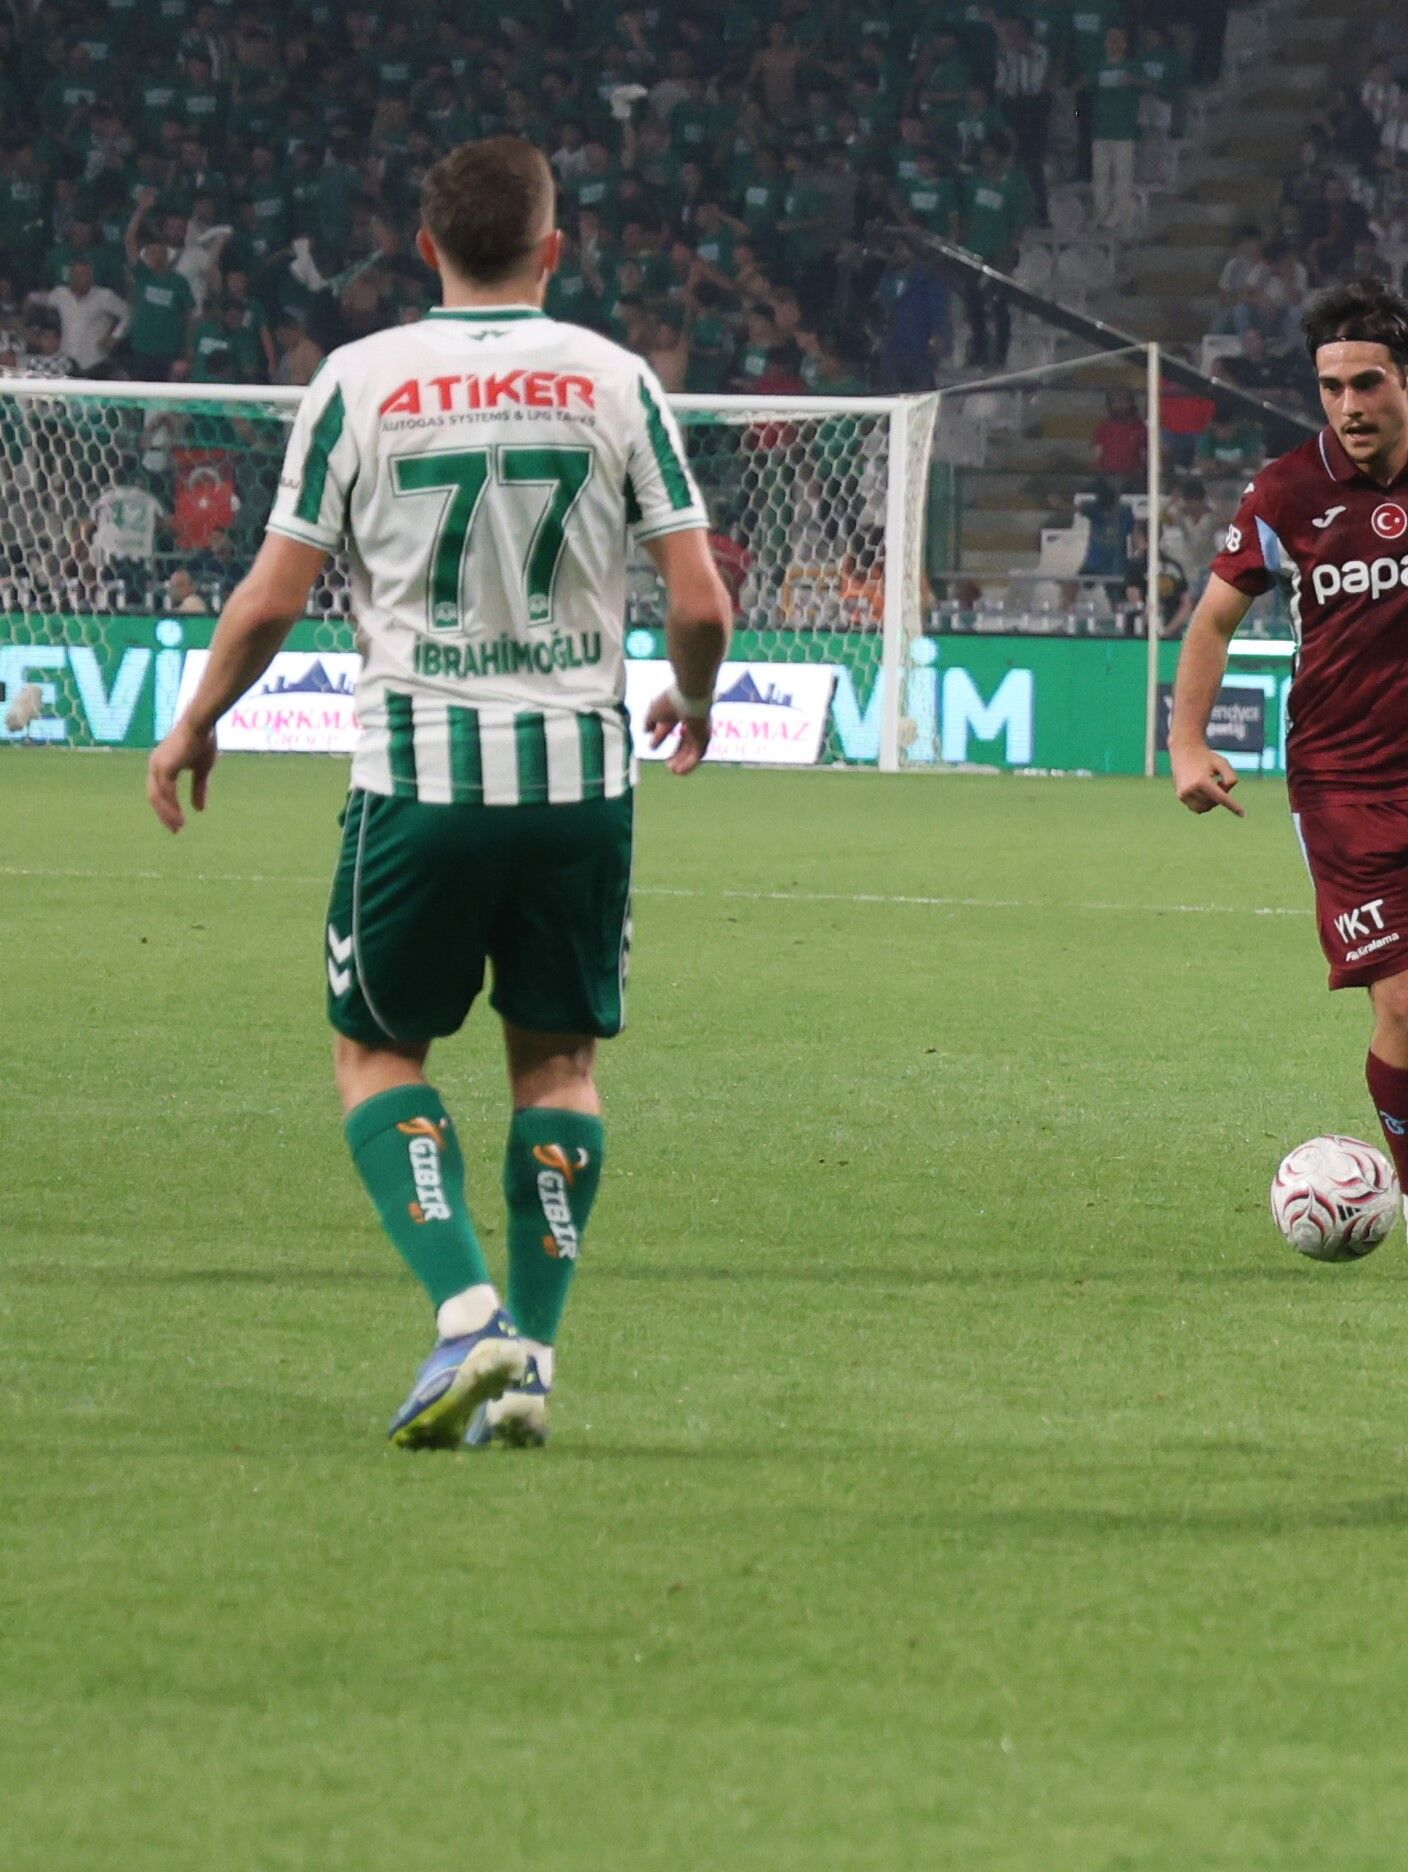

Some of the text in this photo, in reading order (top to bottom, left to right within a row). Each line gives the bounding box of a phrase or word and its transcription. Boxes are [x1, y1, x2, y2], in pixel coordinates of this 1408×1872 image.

[382, 417, 444, 432] AUTOGAS
[450, 410, 510, 425] SYSTEMS
[390, 443, 597, 632] 77
[1333, 898, 1384, 945] YKT
